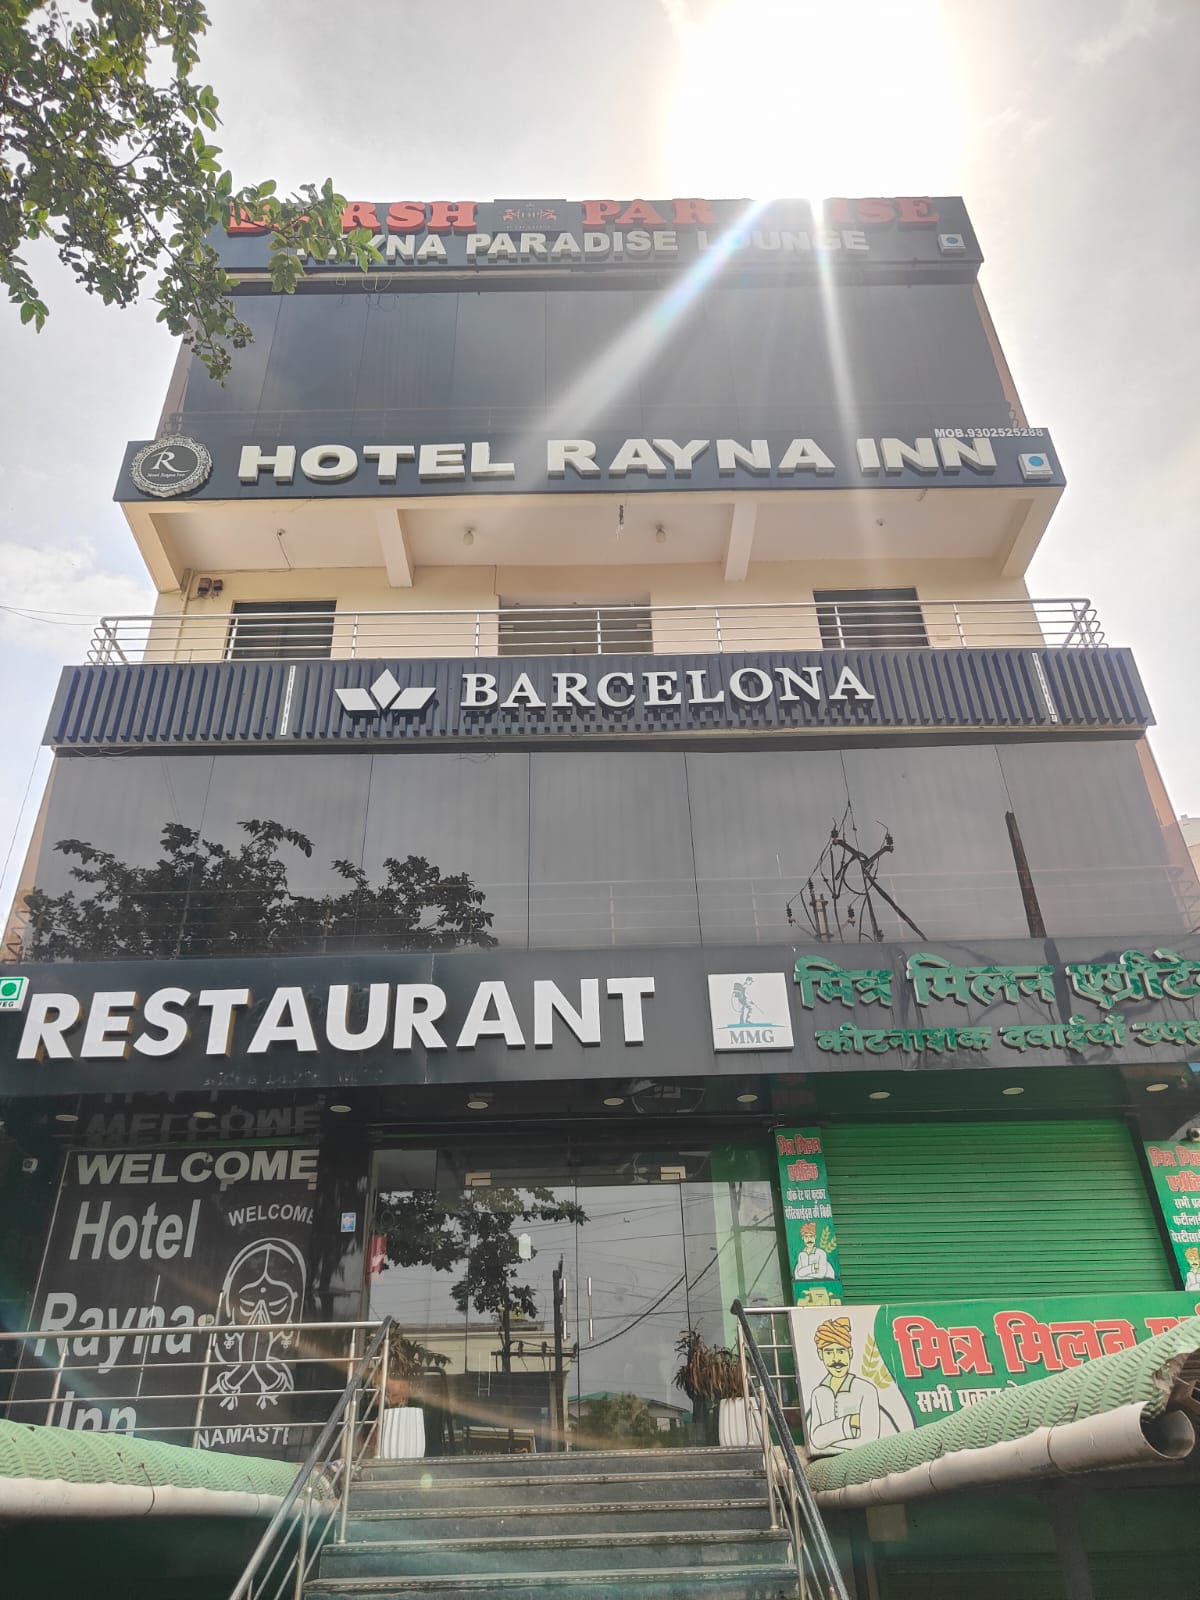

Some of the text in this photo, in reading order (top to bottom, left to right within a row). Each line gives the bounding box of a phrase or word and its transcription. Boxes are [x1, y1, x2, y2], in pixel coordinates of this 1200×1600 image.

[228, 197, 940, 232] RSH PARISE
[466, 230, 680, 258] PARADISE
[697, 229, 870, 251] LUNGE
[238, 437, 998, 483] HOTEL RAYNA INN
[460, 665, 876, 709] BARCELONA
[794, 954, 894, 1009] मित्र
[905, 951, 1056, 1007] मिलन
[17, 976, 656, 1061] RESTAURANT
[729, 1029, 775, 1044] MMG
[814, 1021, 993, 1055] कीटनाशक
[77, 1150, 320, 1185] WELCOME
[68, 1199, 201, 1261] Hotel
[34, 1292, 195, 1374] Rayna
[892, 1315, 993, 1378] मित्र
[58, 1391, 137, 1437] Inn
[915, 1384, 955, 1413] सभी
